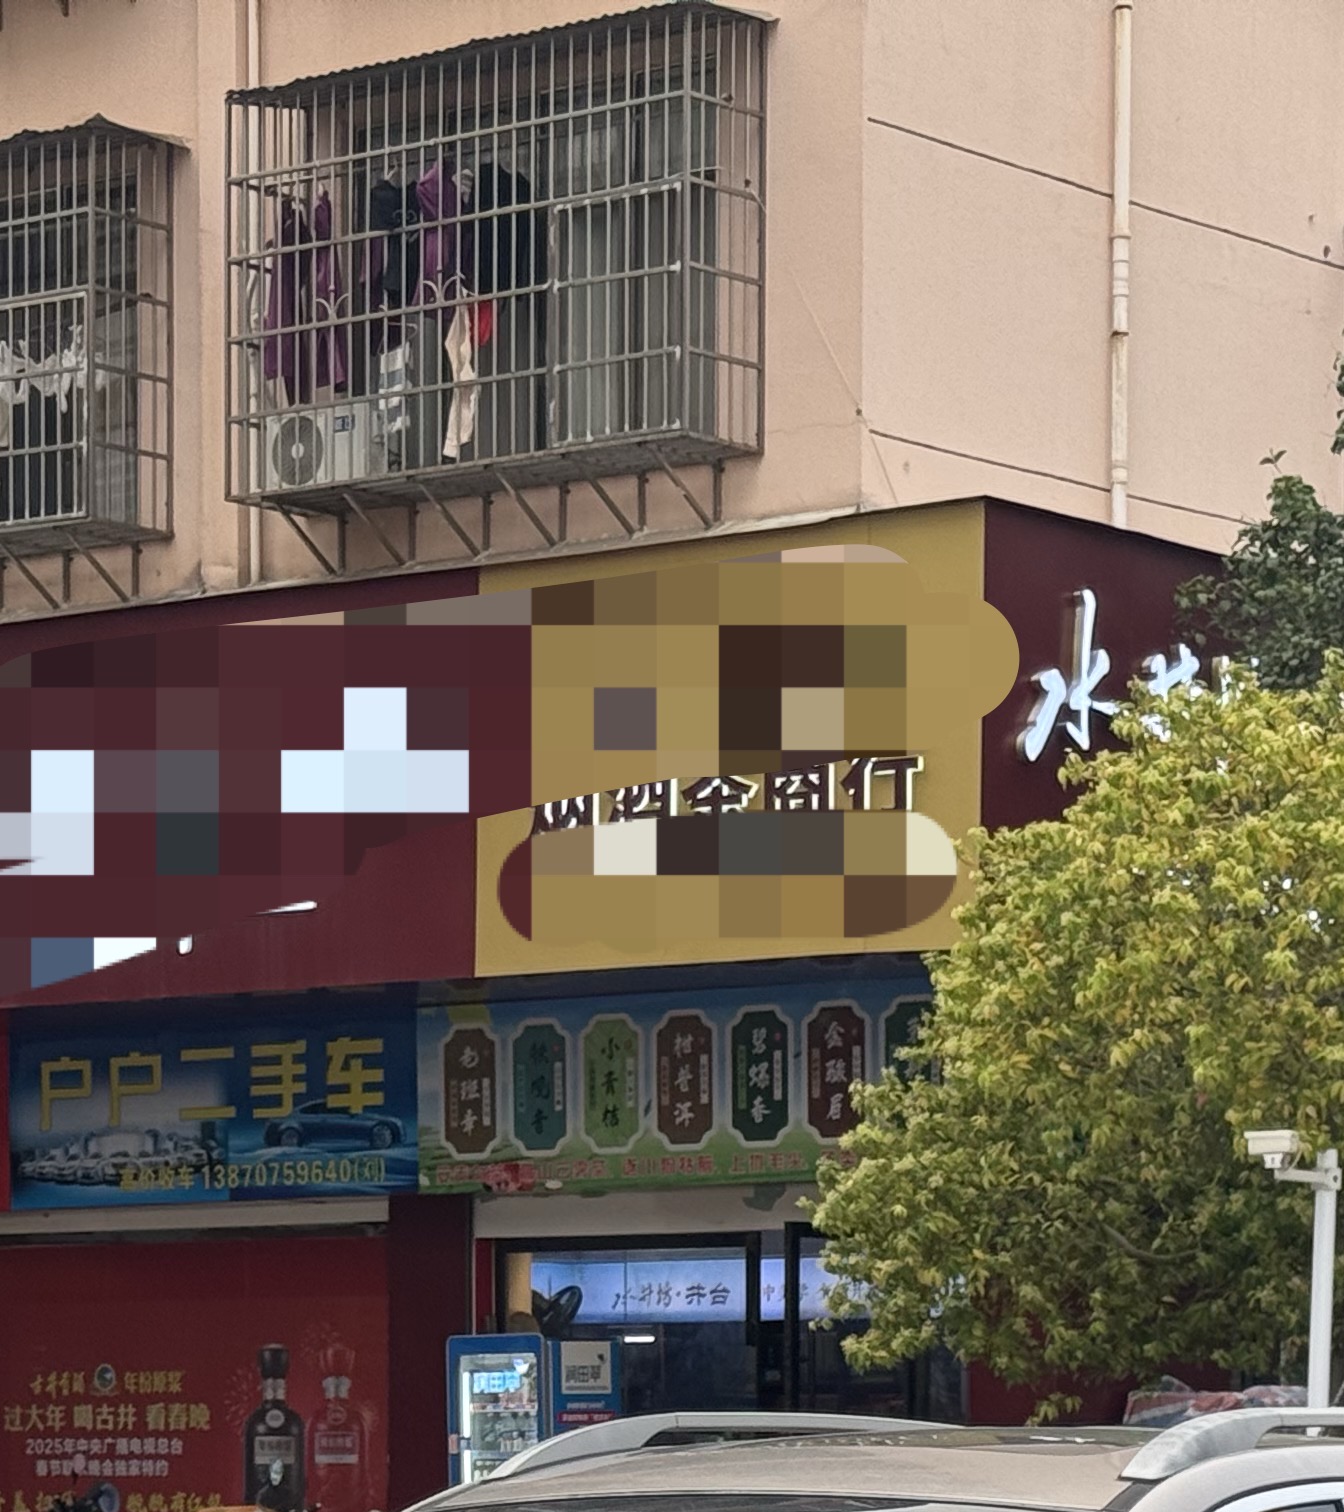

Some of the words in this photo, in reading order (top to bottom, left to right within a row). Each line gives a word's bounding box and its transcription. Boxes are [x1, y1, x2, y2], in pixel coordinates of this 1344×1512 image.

[39, 1037, 385, 1132] 户户二手车
[4, 1404, 66, 1432] 过大年
[146, 1402, 211, 1431] 看春晚
[35, 1458, 170, 1478] 春节联晚会独家特约
